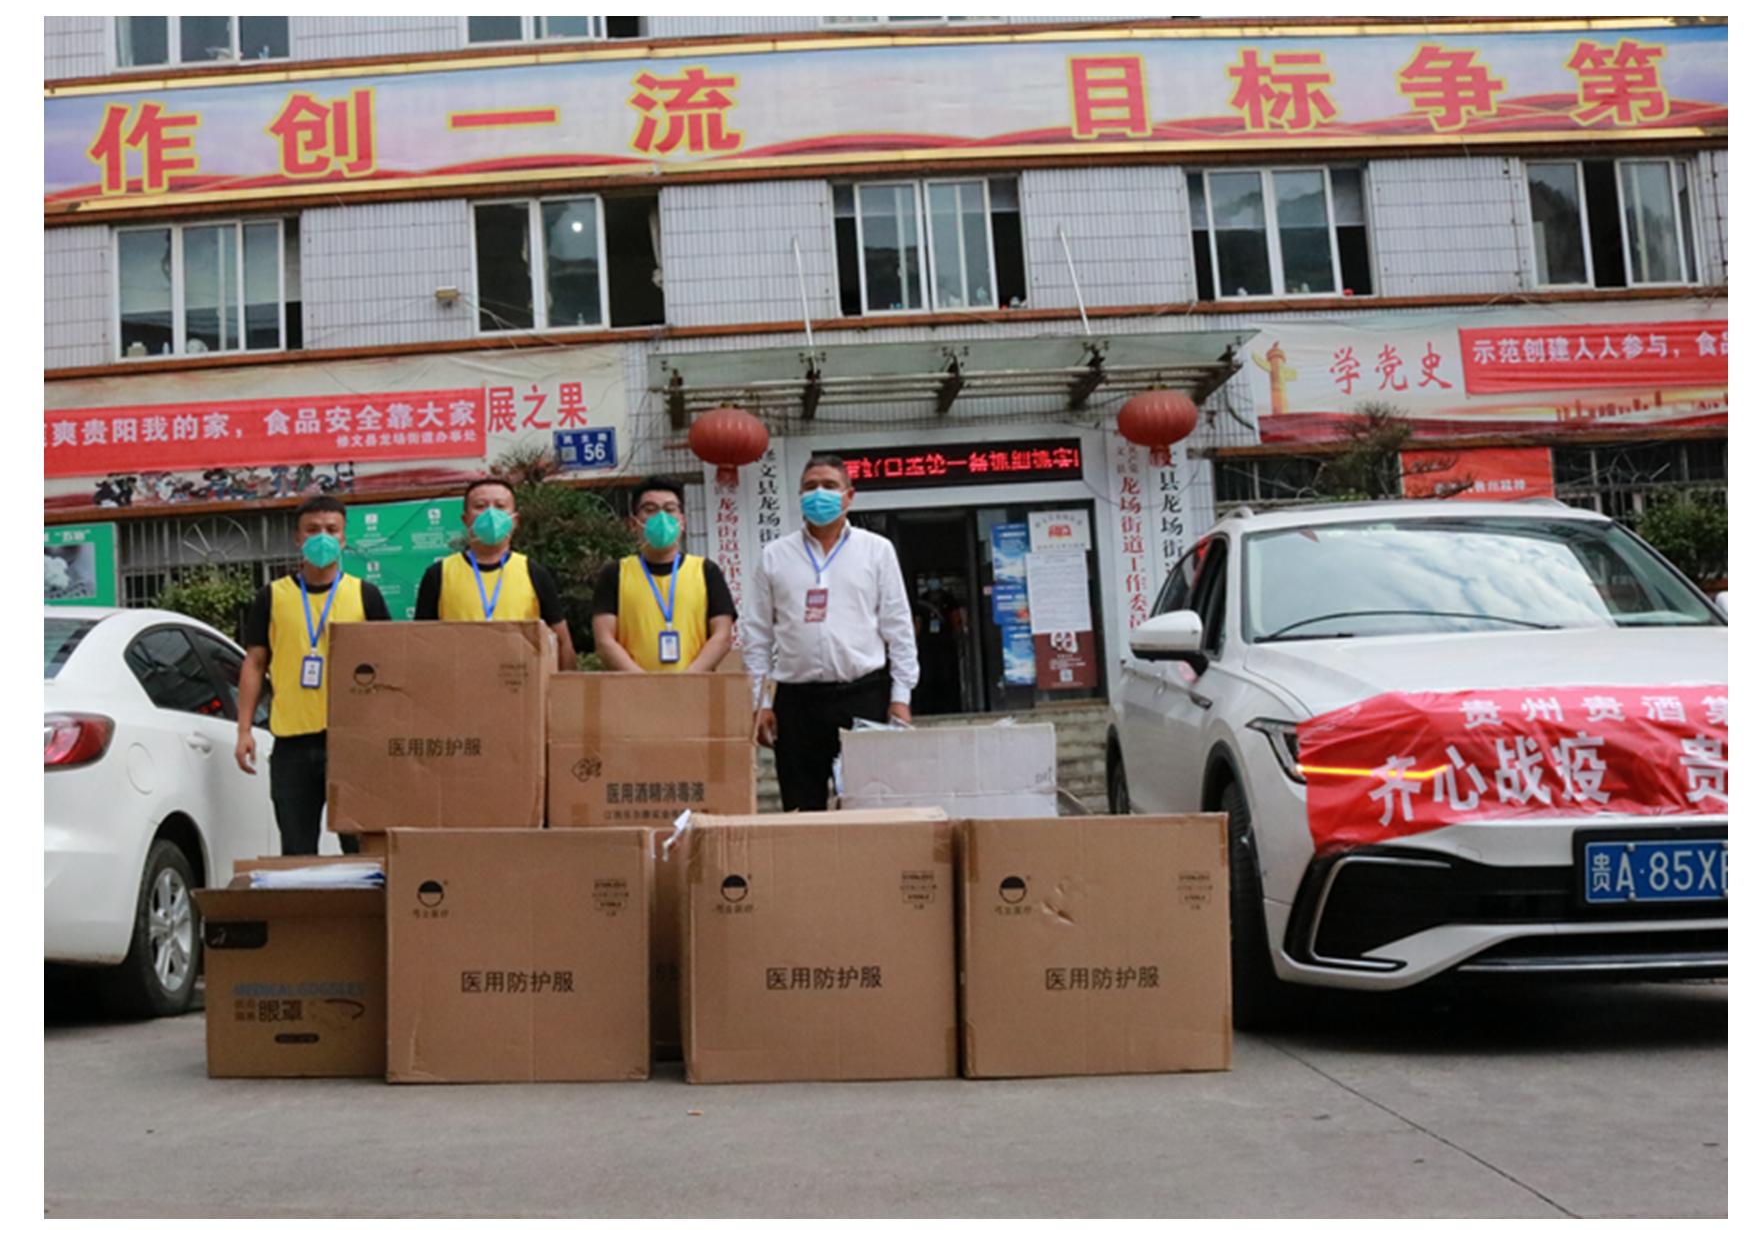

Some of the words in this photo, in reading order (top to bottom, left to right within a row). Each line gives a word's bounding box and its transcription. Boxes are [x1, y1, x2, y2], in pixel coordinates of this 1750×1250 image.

[90, 64, 745, 196] 作创一流
[1066, 37, 1672, 140] 目标争第
[1329, 342, 1453, 395] 学党史
[487, 381, 588, 435] 展之果
[44, 400, 476, 448] 爽贵阳我的家，食品安全靠大家
[336, 428, 478, 449] 修文县龙场街道办事处
[583, 443, 606, 462] 56
[1159, 452, 1184, 574] 县龙场街
[387, 737, 482, 758] 医用防护服
[606, 781, 705, 804] 医用酒精消毒液
[1369, 732, 1612, 827] 齐心战疫
[1680, 733, 1728, 805] 贵
[460, 970, 575, 994] 医用防护服
[765, 965, 883, 991] 医用防护服
[1044, 965, 1160, 991] 医用防护服
